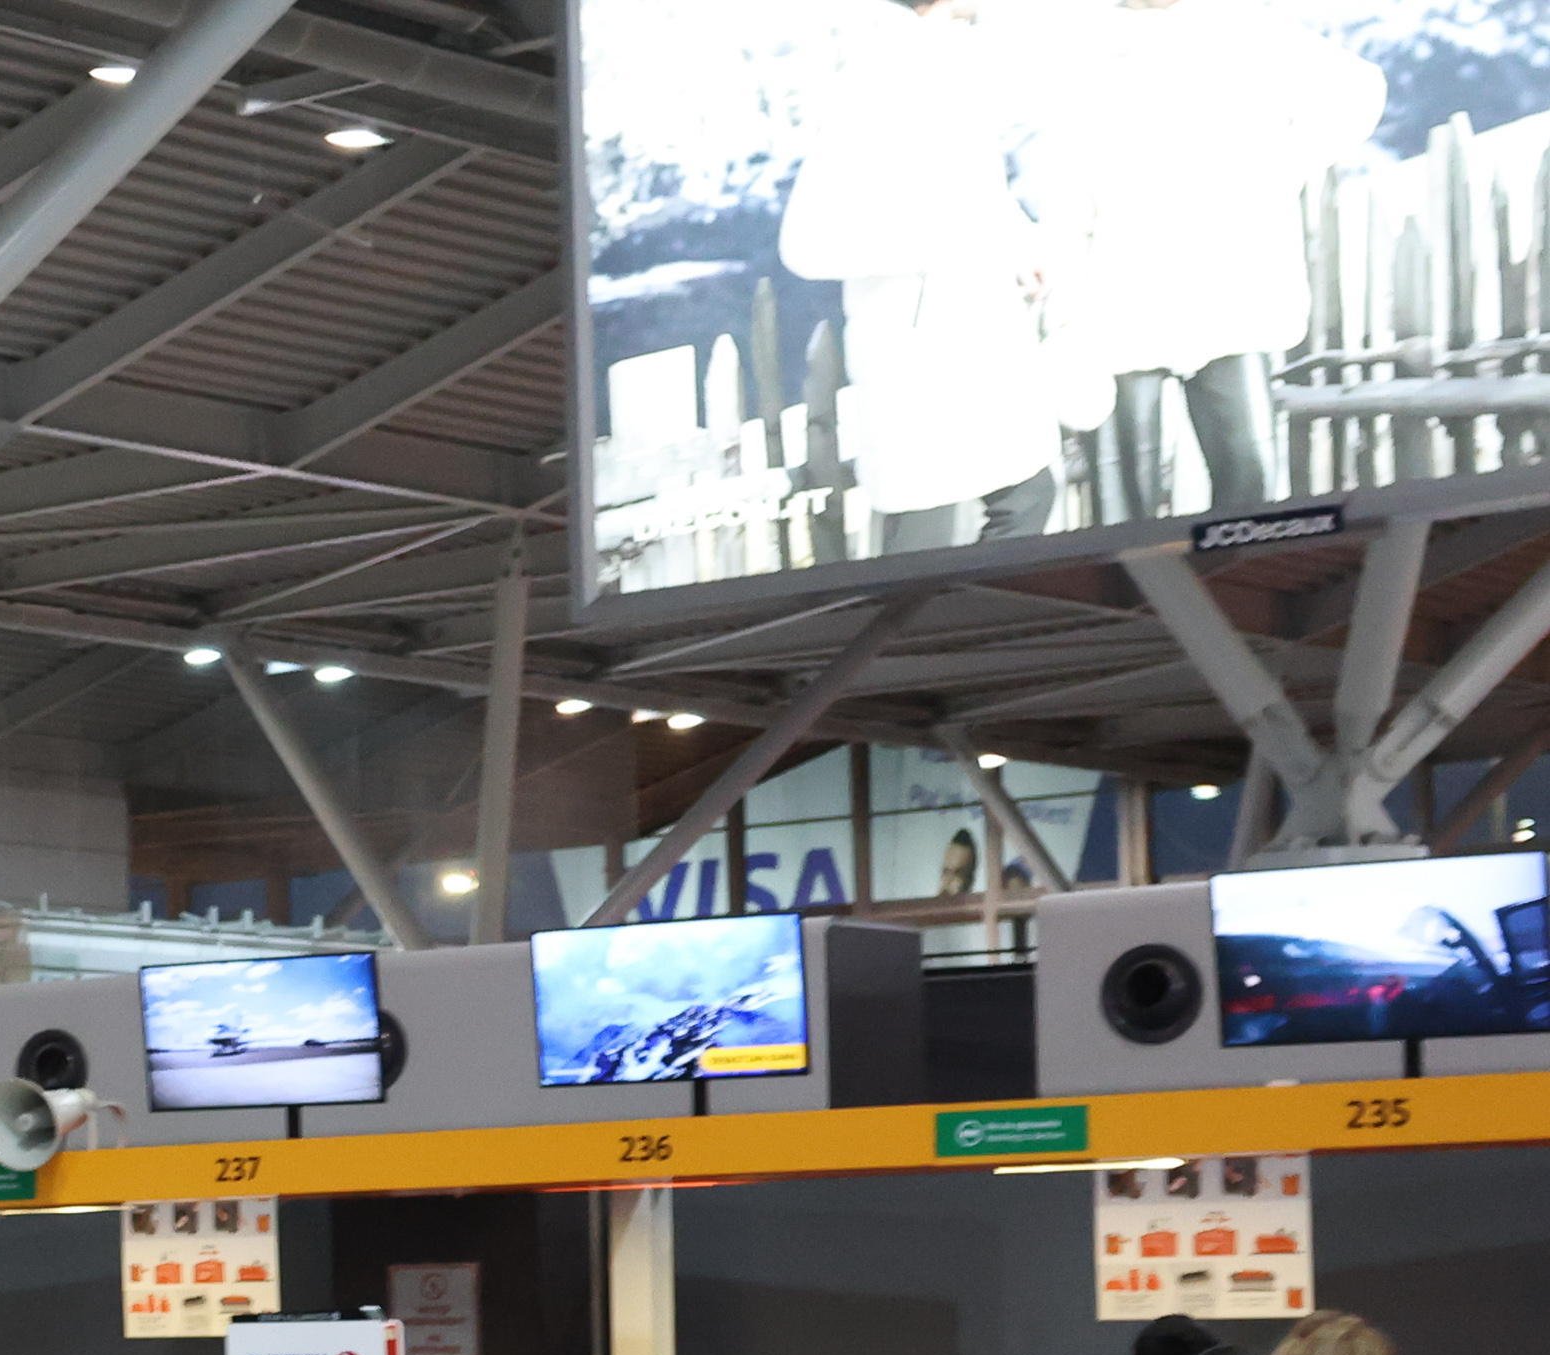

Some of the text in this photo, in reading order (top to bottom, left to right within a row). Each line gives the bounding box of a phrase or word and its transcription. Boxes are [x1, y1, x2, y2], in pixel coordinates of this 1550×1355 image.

[1200, 513, 1336, 549] JCDecaux
[636, 846, 850, 921] VISA
[1346, 1098, 1412, 1128] 235
[619, 1135, 673, 1162] 236
[215, 1157, 262, 1182] 237
